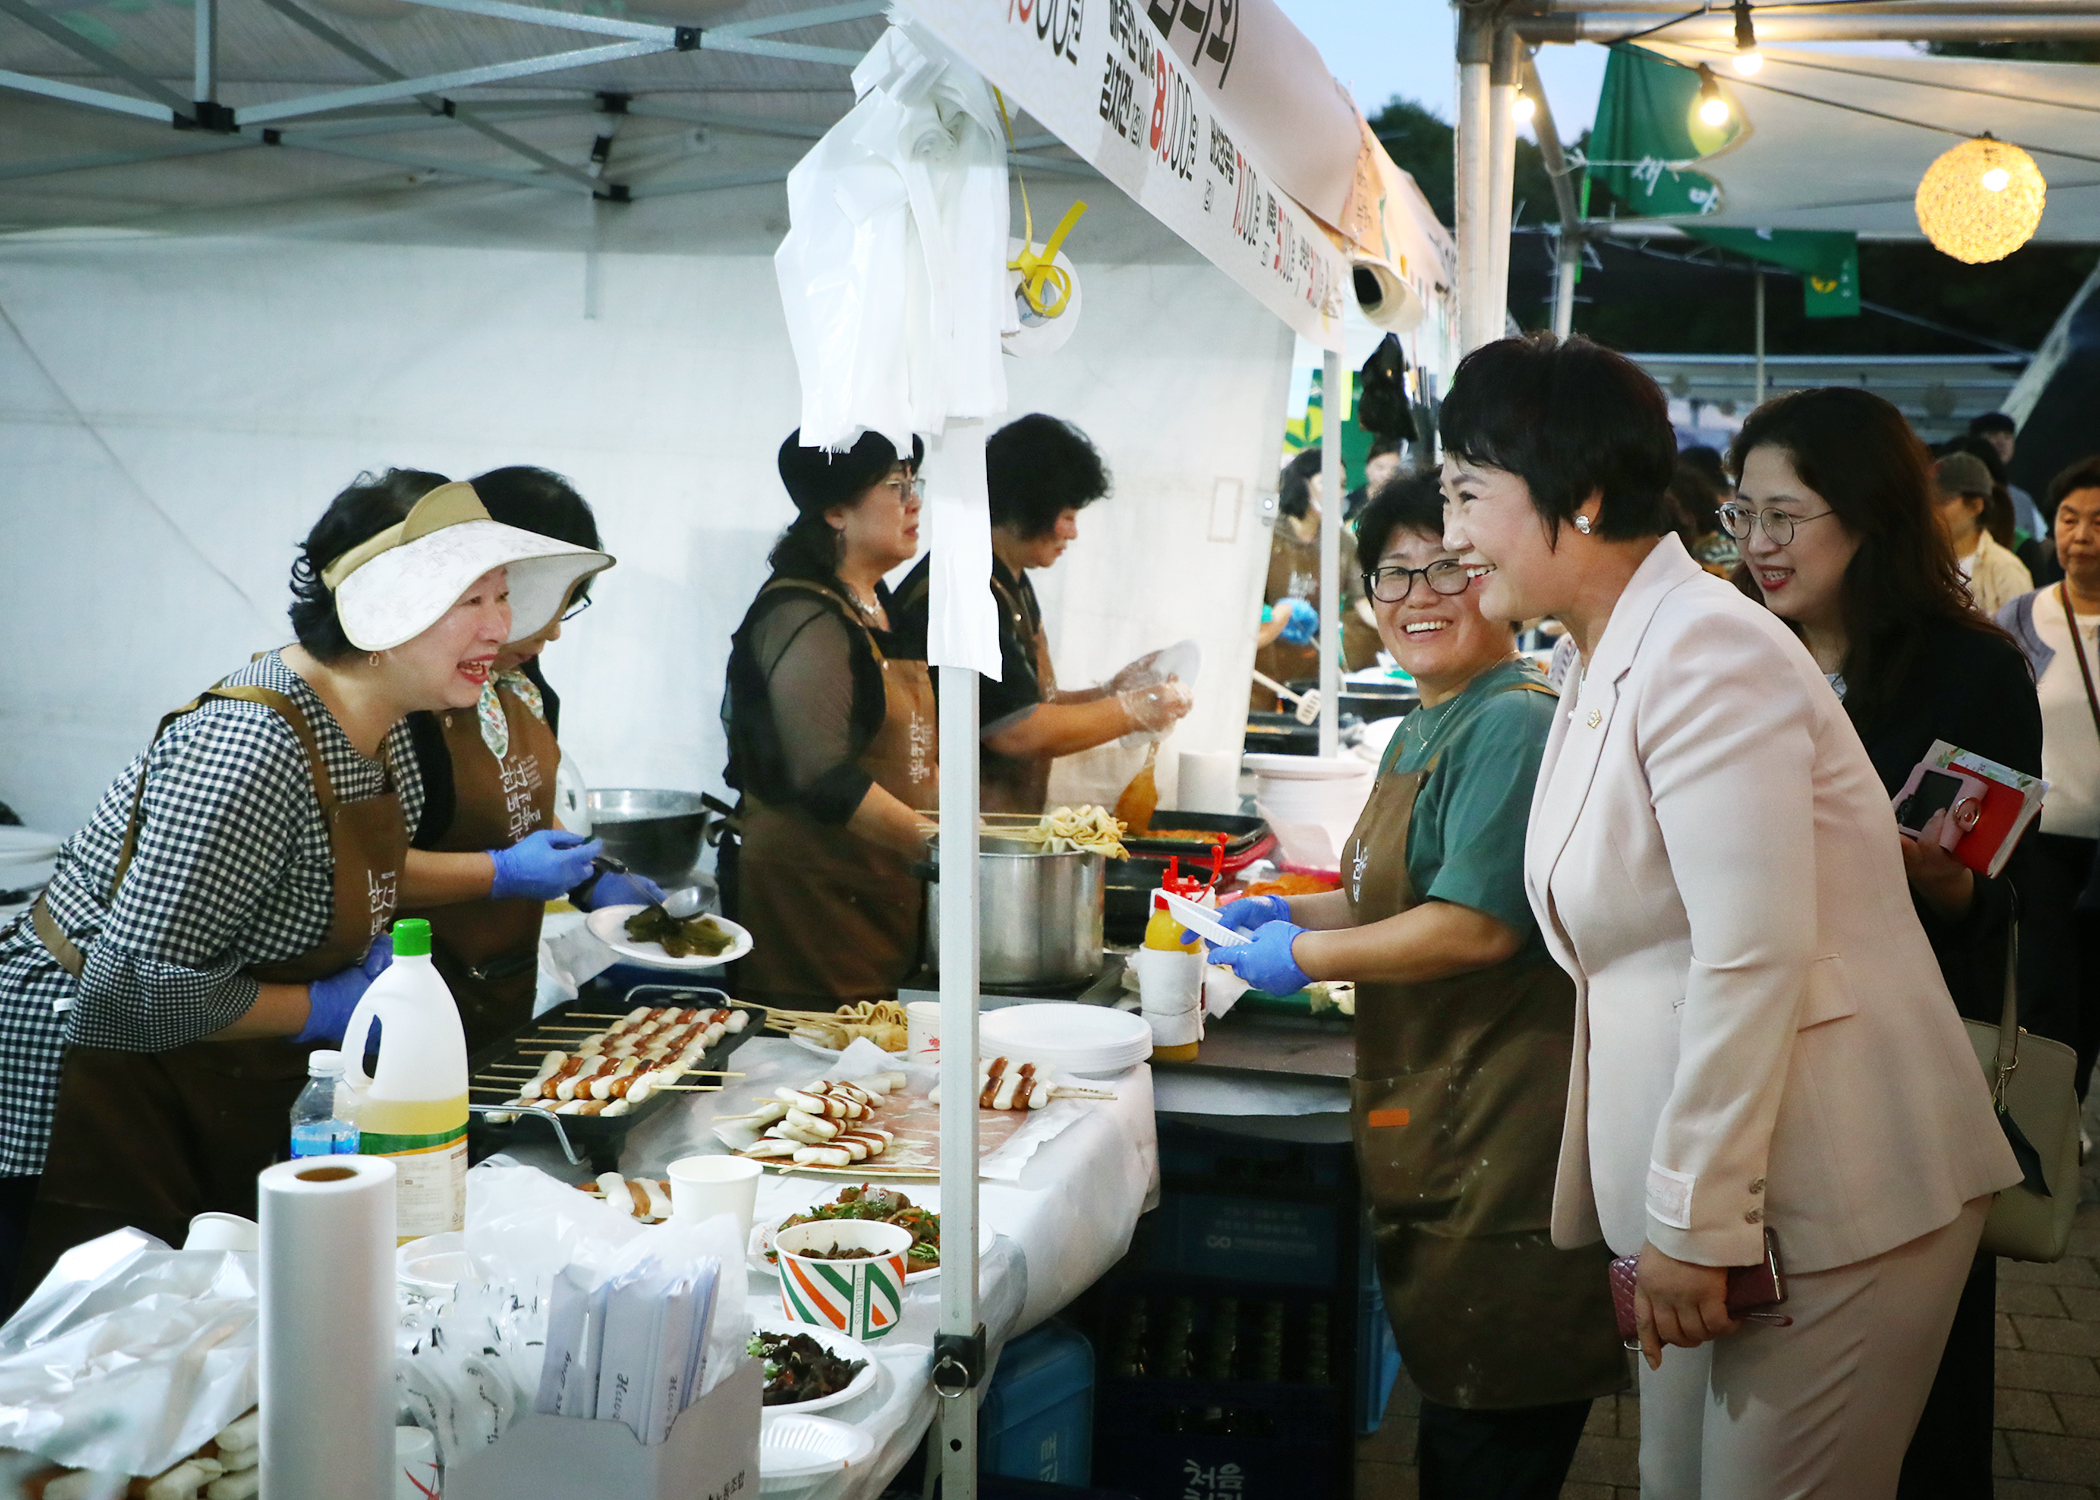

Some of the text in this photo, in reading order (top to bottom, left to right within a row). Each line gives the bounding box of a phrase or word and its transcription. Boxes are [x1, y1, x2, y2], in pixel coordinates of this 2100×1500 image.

[1100, 52, 1134, 138] 김치전
[1150, 48, 1199, 181] 8,000원
[855, 1277, 864, 1325] DELICIOUS
[1184, 1459, 1245, 1490] 처음
